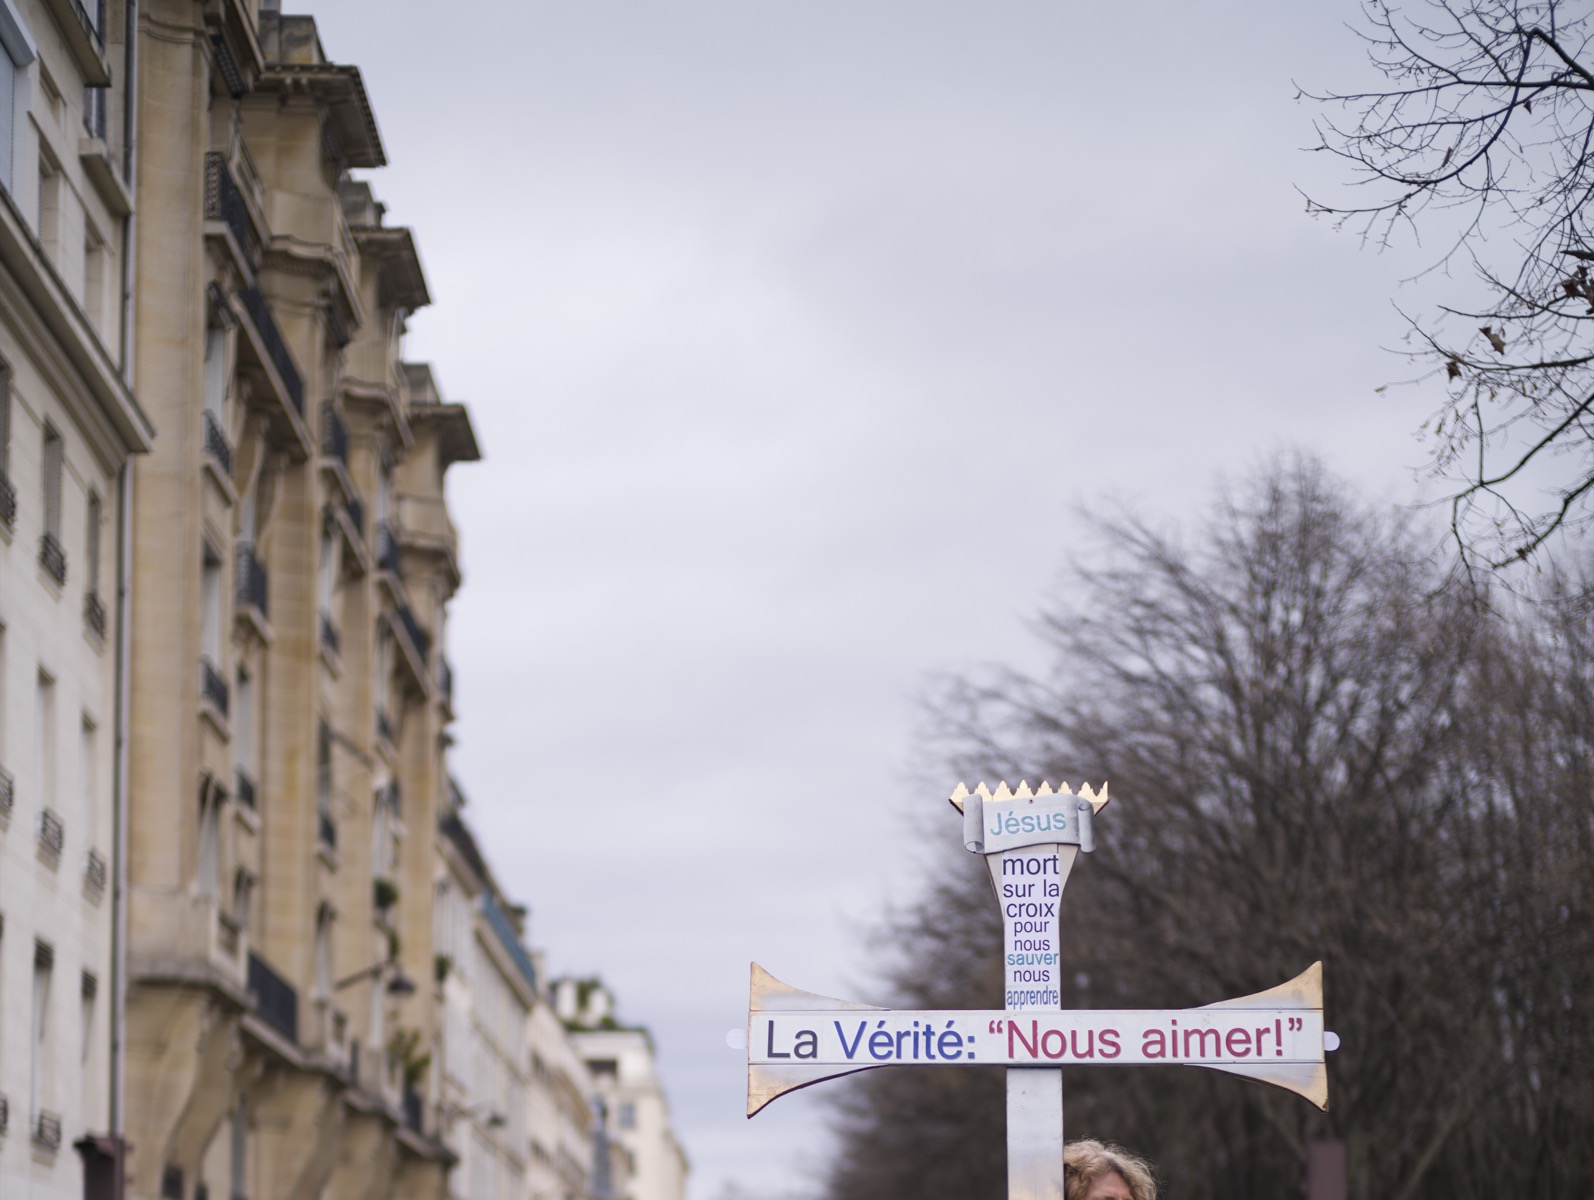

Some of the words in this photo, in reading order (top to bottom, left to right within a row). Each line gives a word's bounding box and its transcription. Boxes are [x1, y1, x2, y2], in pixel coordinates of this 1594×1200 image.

[990, 811, 1067, 836] Jésus
[1002, 854, 1059, 875] mort
[1003, 883, 1035, 898] sur
[1043, 879, 1060, 898] la
[1006, 902, 1054, 918] croix
[1014, 920, 1050, 936] pour
[1014, 939, 1050, 951] nous
[1007, 952, 1059, 966] sauver
[1013, 969, 1050, 982] nous
[1006, 985, 1059, 1010] apprendre
[767, 1020, 818, 1059] La
[834, 1020, 976, 1060] Vérité:
[988, 1019, 1122, 1059] “Nous
[1141, 1017, 1303, 1058] aimer!”
